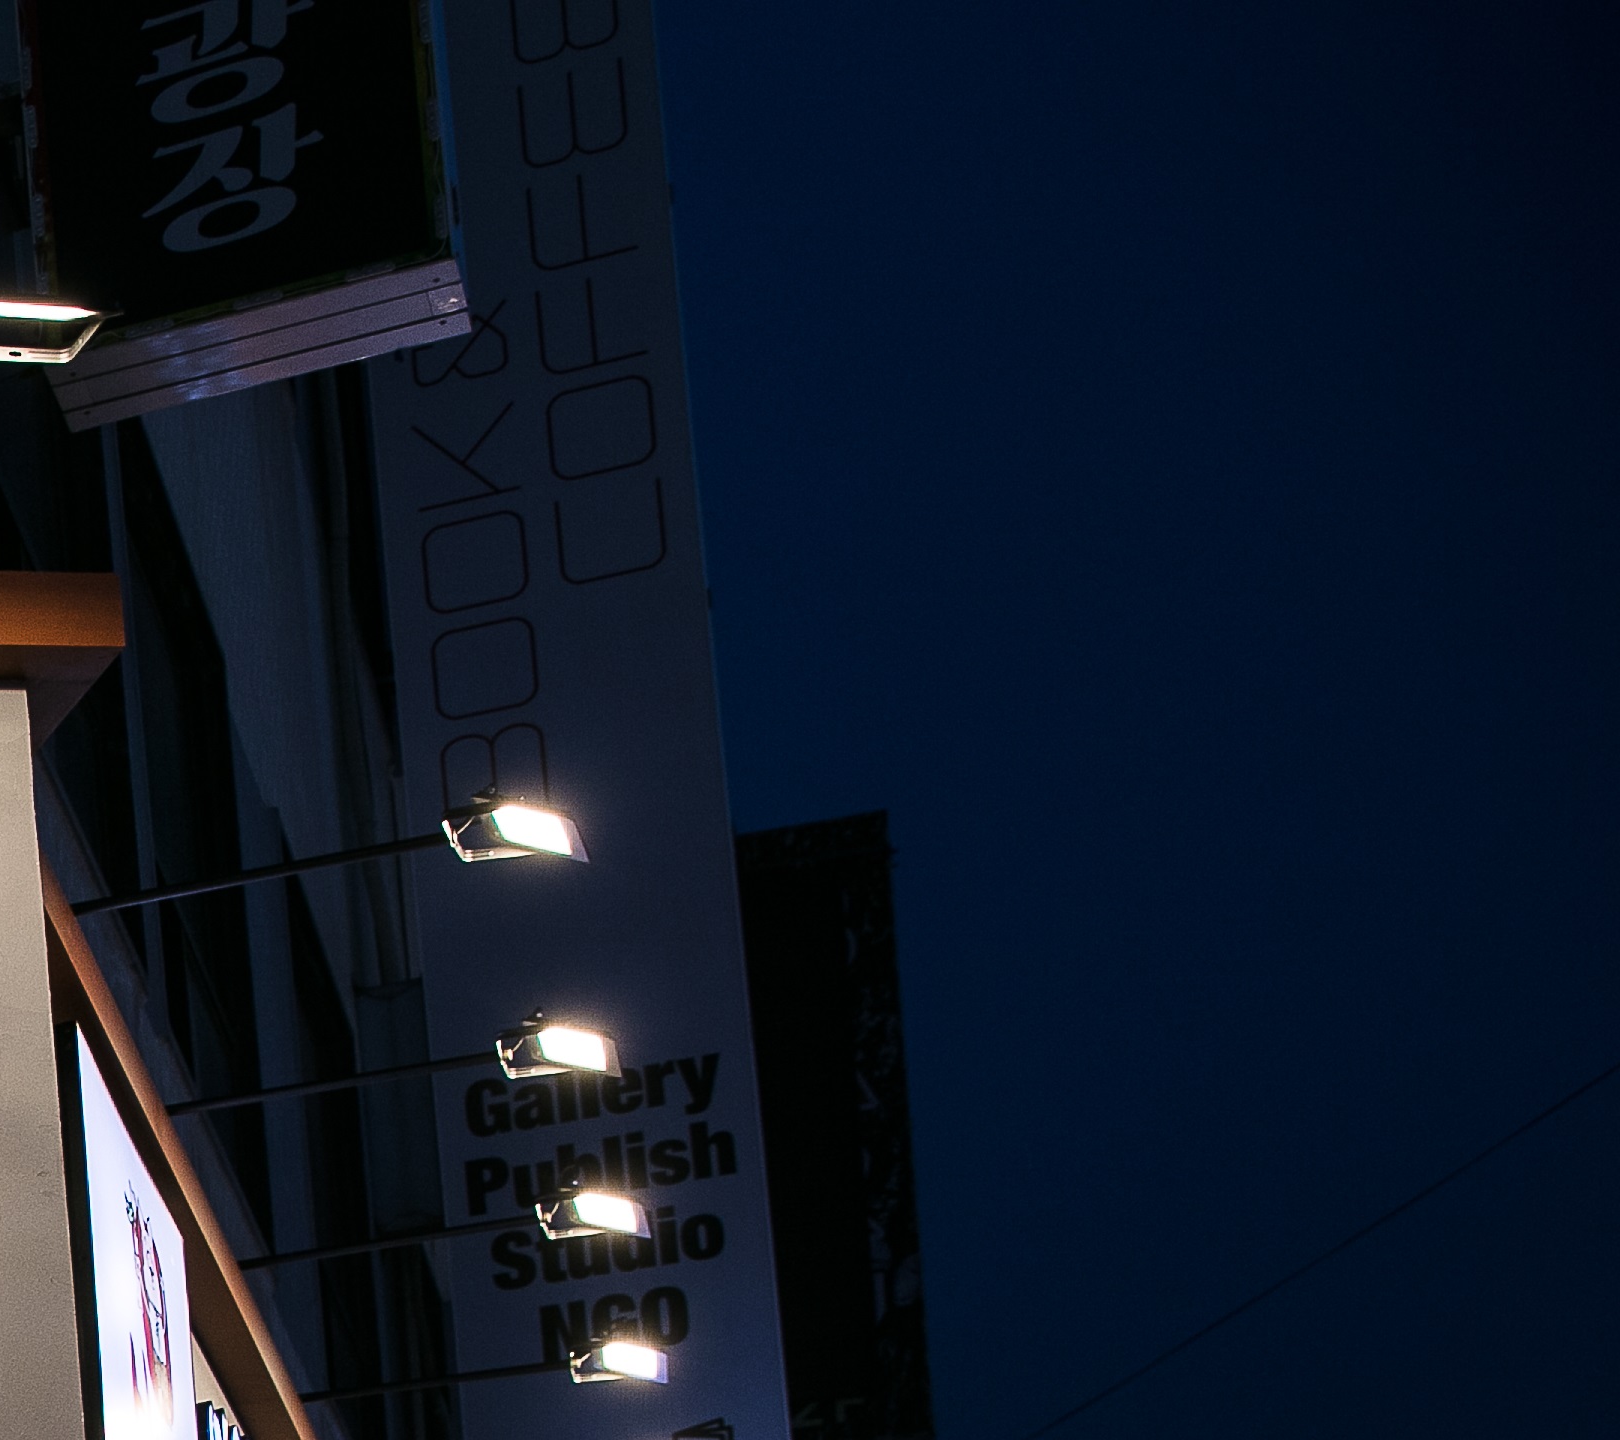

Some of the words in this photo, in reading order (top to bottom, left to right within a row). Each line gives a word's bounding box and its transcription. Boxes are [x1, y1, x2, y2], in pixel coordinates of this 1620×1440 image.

[412, 402, 548, 812] BOOK
[465, 1053, 720, 1137] Gallery
[465, 1121, 737, 1216] Publish
[491, 1205, 725, 1291] Studio
